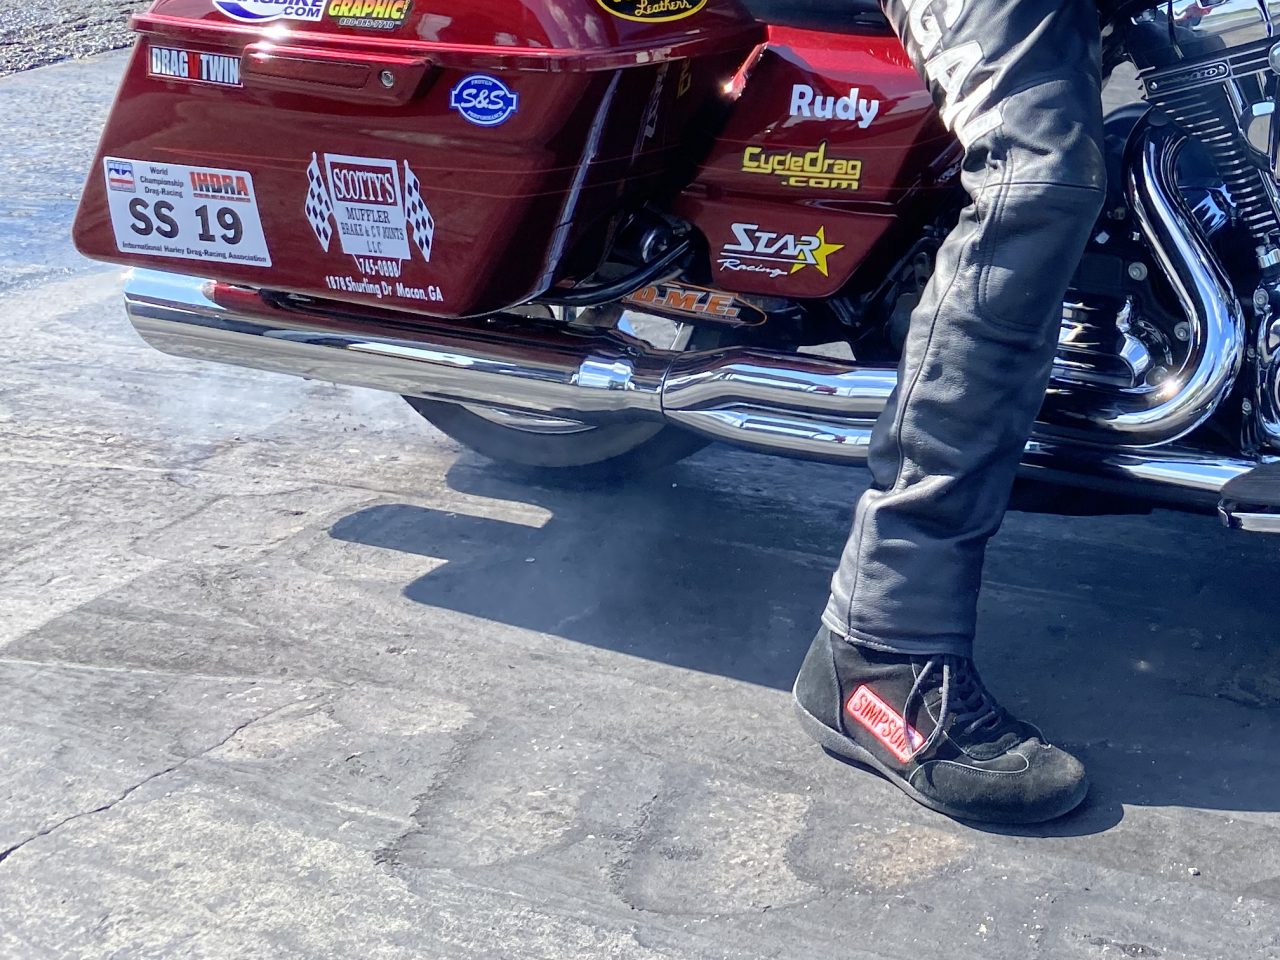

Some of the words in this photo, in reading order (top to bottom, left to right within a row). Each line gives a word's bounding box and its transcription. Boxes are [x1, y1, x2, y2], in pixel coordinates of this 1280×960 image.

[460, 88, 505, 110] S&S
[789, 84, 879, 128] Rudy
[149, 166, 169, 176] World
[741, 141, 862, 180] CycleDrag
[140, 176, 184, 188] Championship
[144, 186, 184, 198] Drag-Racing
[333, 168, 395, 203] SCOTTY'S
[781, 177, 859, 190] .com
[128, 197, 179, 239] SS
[195, 204, 244, 245] 19
[345, 206, 391, 224] MUFFLER
[122, 241, 163, 252] International
[163, 243, 185, 255] Harley
[186, 247, 227, 260] Drag-Racing
[228, 251, 267, 263] Association
[723, 222, 820, 265] STAR
[717, 258, 788, 278] Racing
[345, 276, 382, 299] Shurling
[381, 281, 393, 296] Dr
[428, 285, 444, 302] GA
